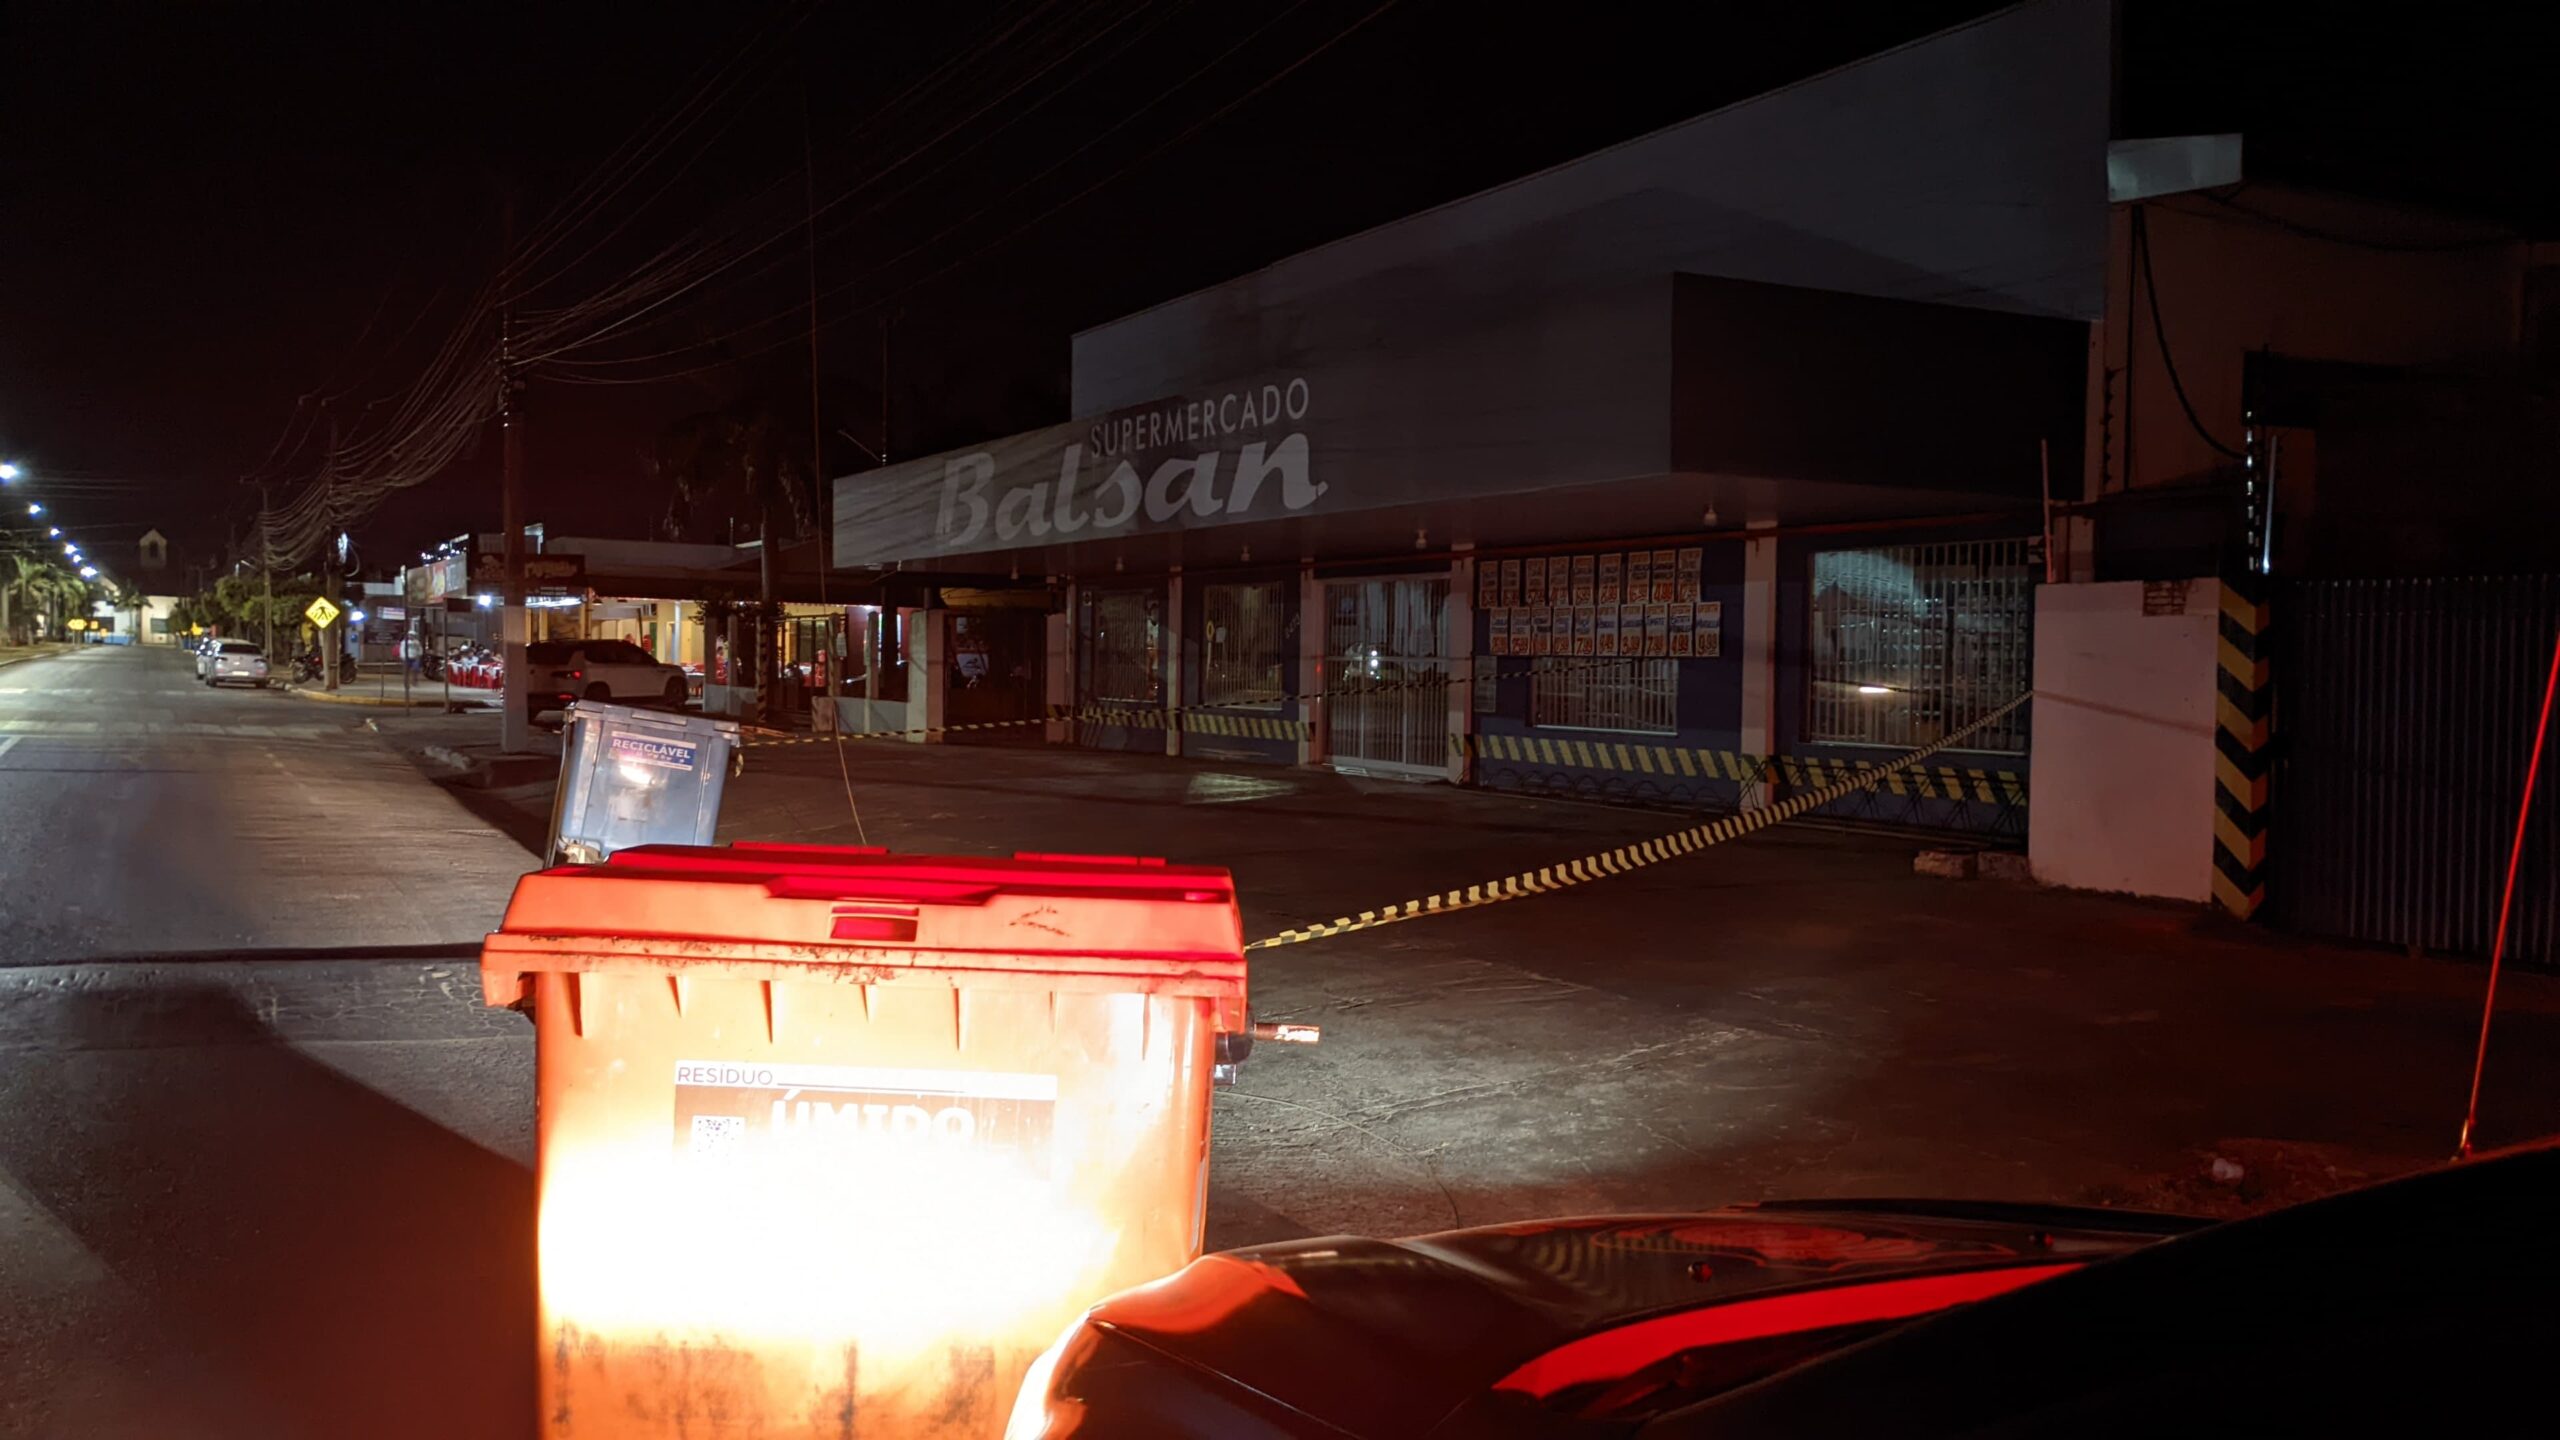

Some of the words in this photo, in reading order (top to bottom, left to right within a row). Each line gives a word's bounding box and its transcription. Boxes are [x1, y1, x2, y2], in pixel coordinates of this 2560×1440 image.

[1090, 377, 1310, 459] SUPERMERCADO
[934, 432, 1329, 548] Balsan
[612, 738, 692, 759] RECICLÁVEL
[677, 1064, 773, 1086] RESÍDUO
